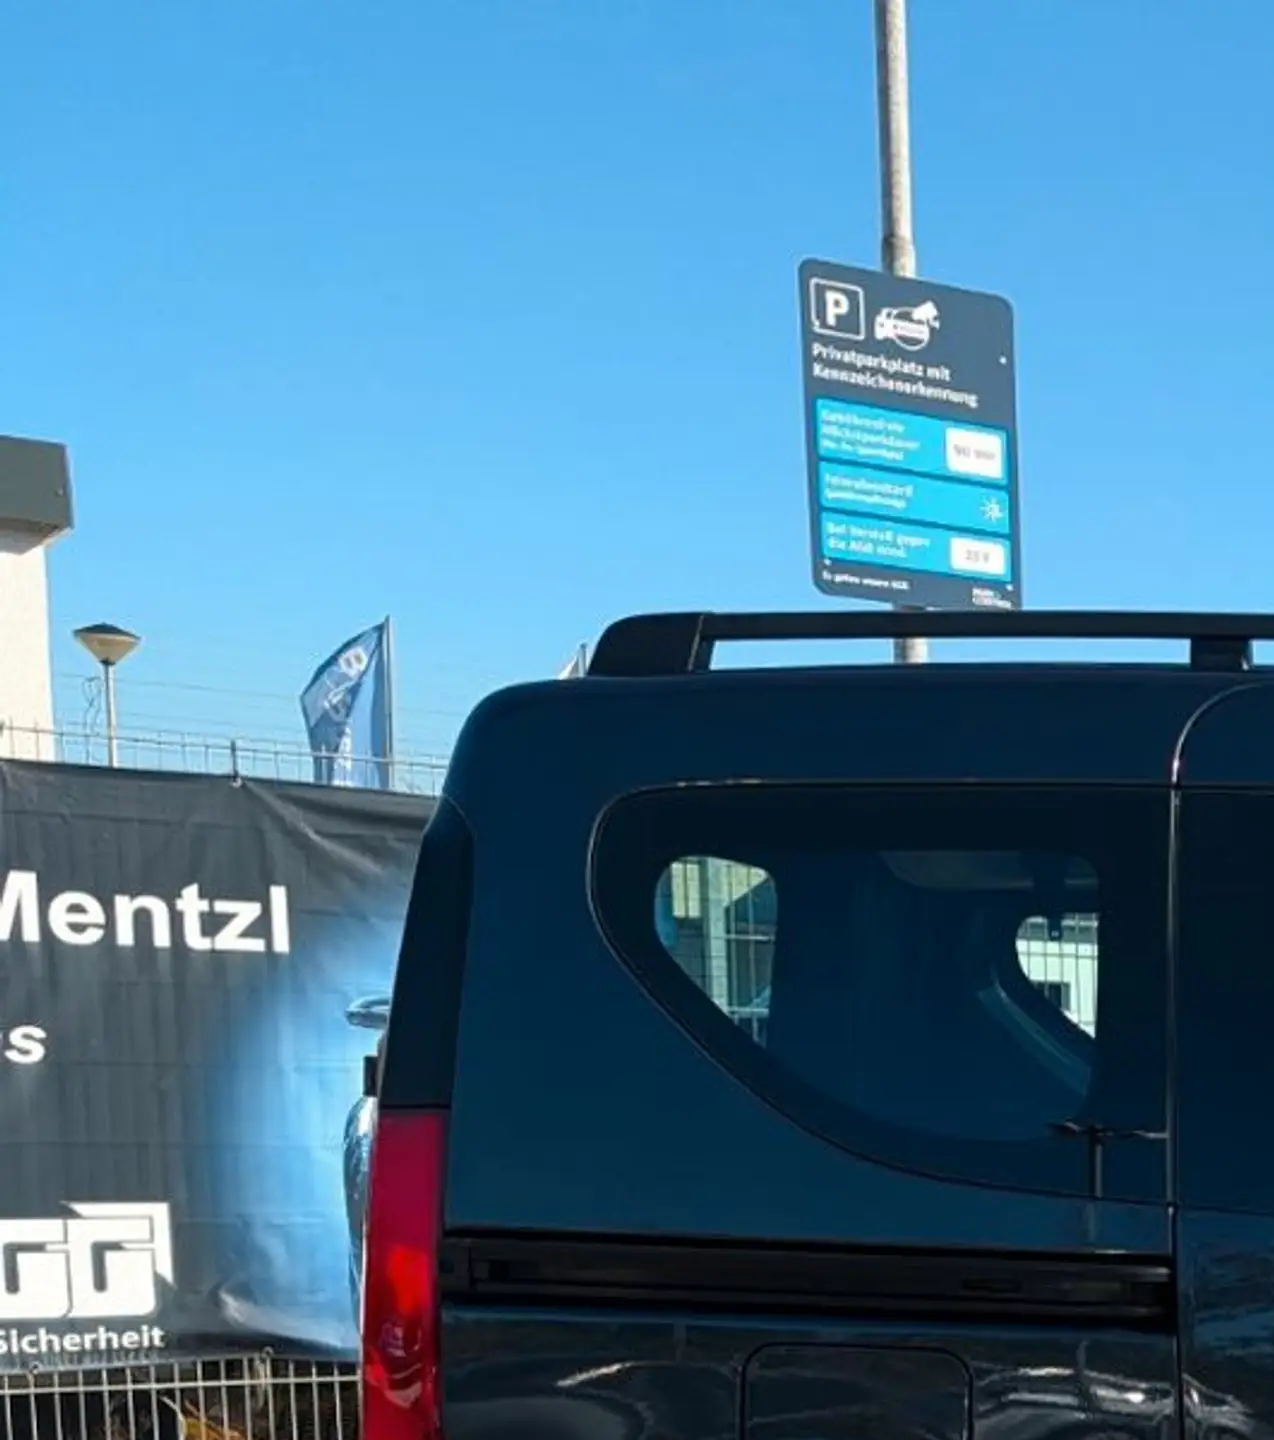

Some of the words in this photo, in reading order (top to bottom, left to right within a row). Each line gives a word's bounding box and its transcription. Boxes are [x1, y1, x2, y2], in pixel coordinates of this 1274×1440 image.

[825, 289, 849, 327] P
[813, 343, 924, 376] Privatparkplatz
[926, 366, 951, 382] mit
